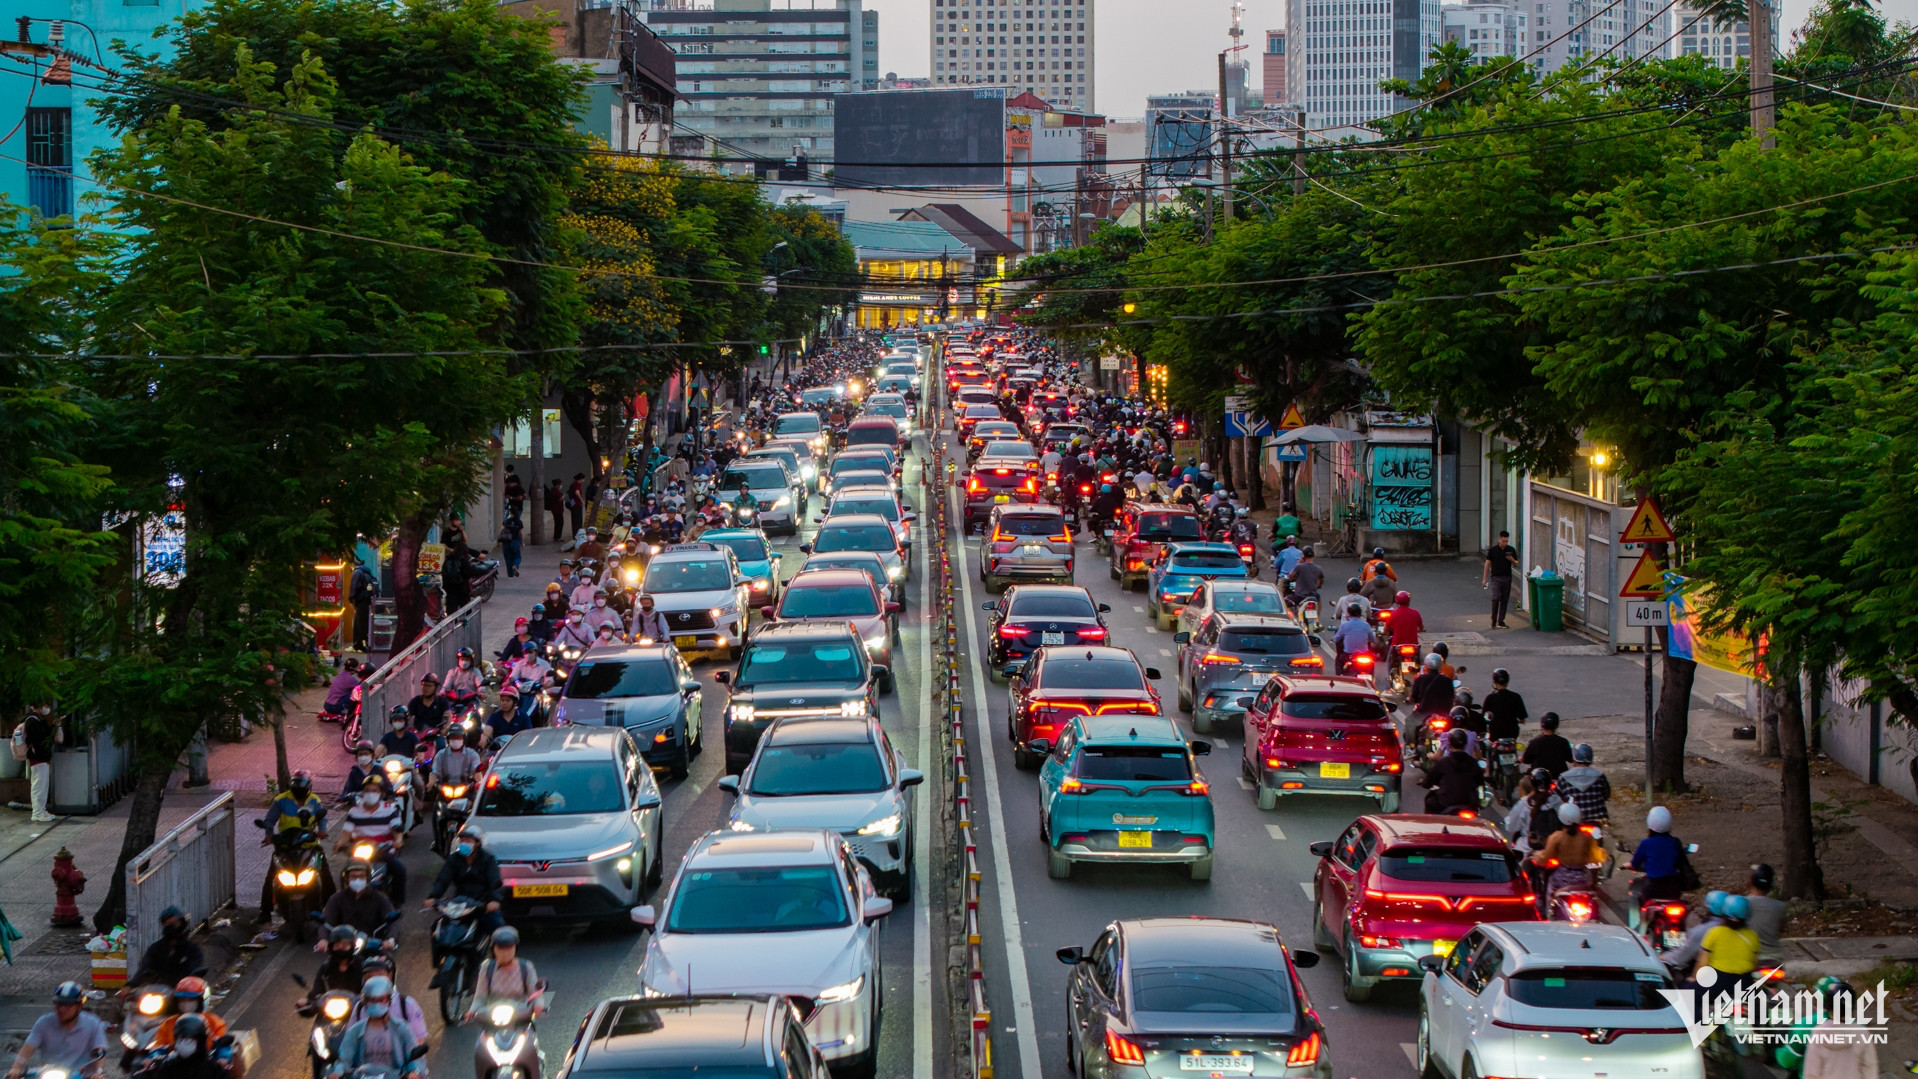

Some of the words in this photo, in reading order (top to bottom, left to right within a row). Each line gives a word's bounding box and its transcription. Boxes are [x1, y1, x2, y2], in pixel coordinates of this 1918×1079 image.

[1635, 607, 1648, 620] 40
[1652, 609, 1662, 620] m
[1186, 1057, 1248, 1068] 51L-393.64
